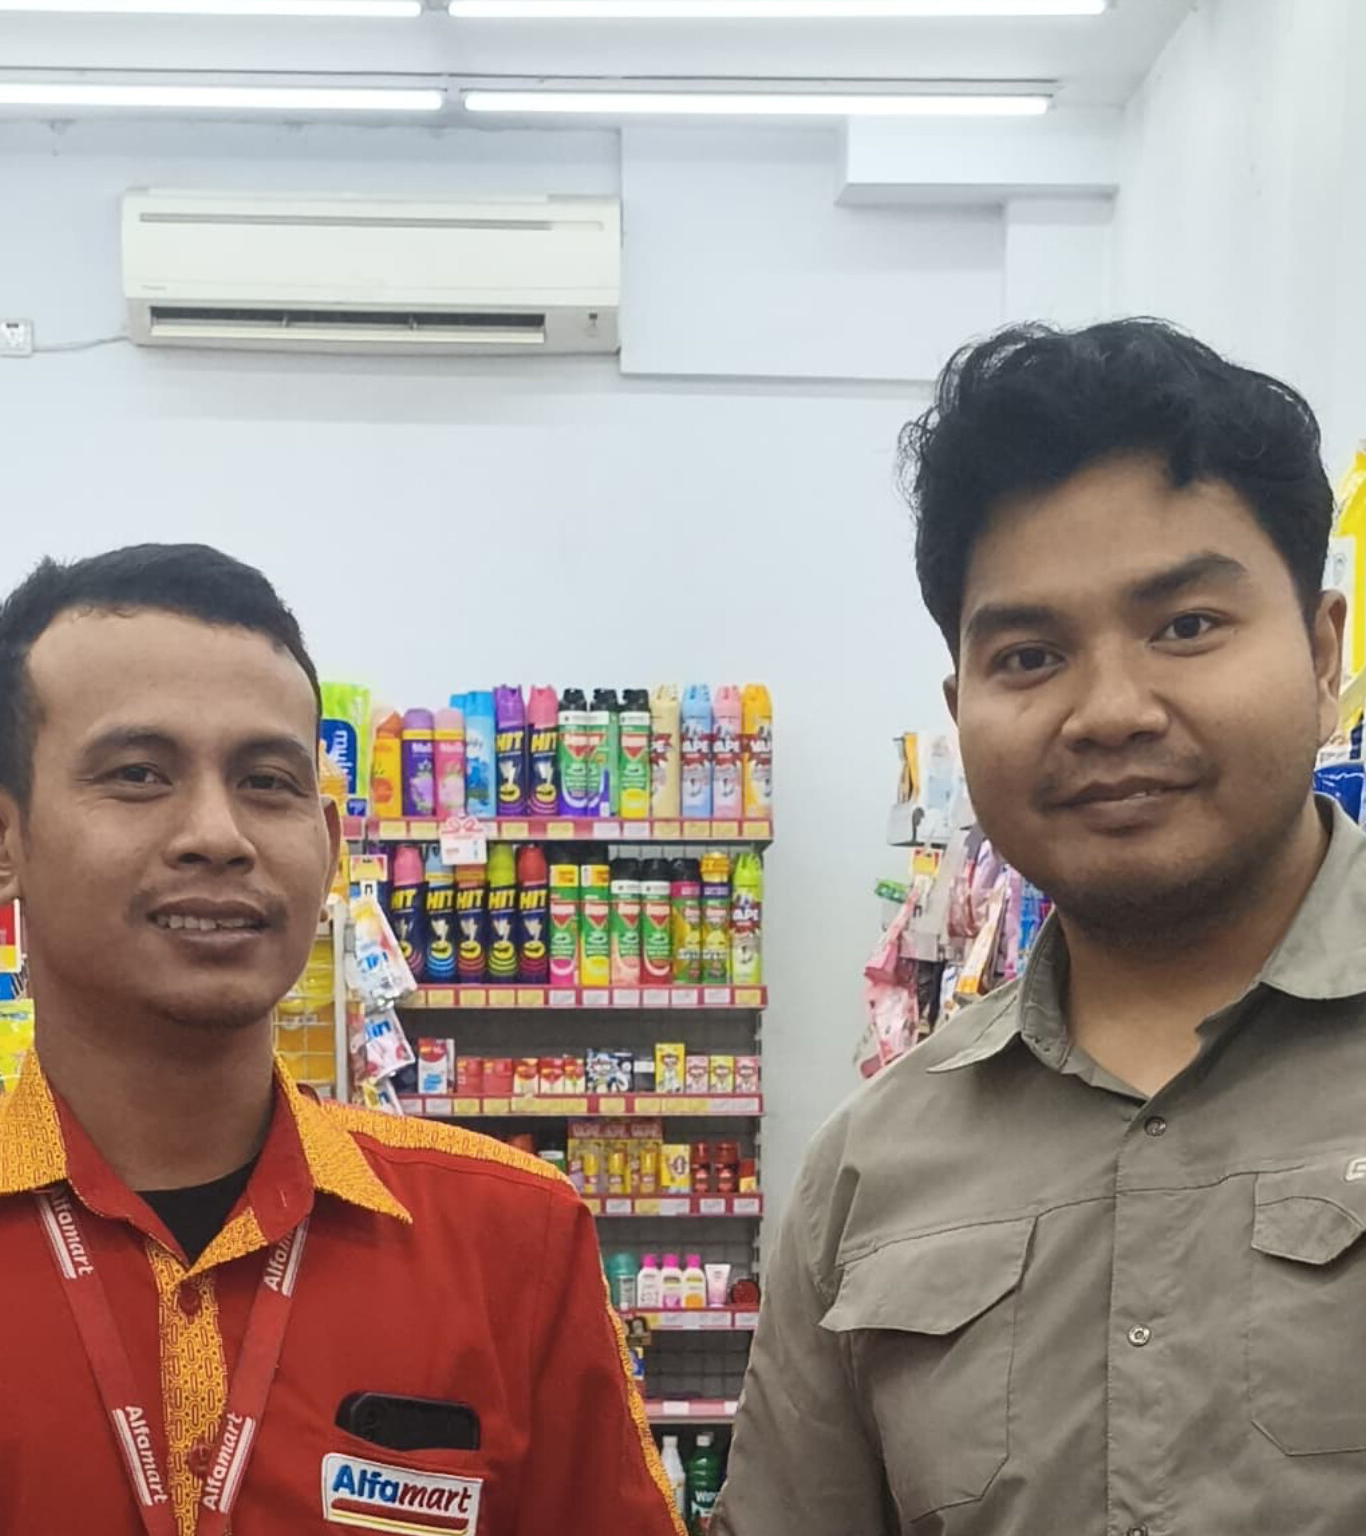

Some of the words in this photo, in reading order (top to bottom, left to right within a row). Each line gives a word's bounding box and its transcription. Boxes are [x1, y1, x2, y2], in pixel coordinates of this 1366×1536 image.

[496, 731, 524, 754] HIT
[531, 731, 557, 754] HIT
[426, 889, 454, 911] HIT
[456, 889, 483, 911] HIT
[488, 888, 516, 910] HIT
[519, 888, 547, 910] HIT
[125, 1404, 169, 1508] Alfamart
[202, 1411, 244, 1513] Alfamart
[331, 1461, 473, 1515] Alfamart
